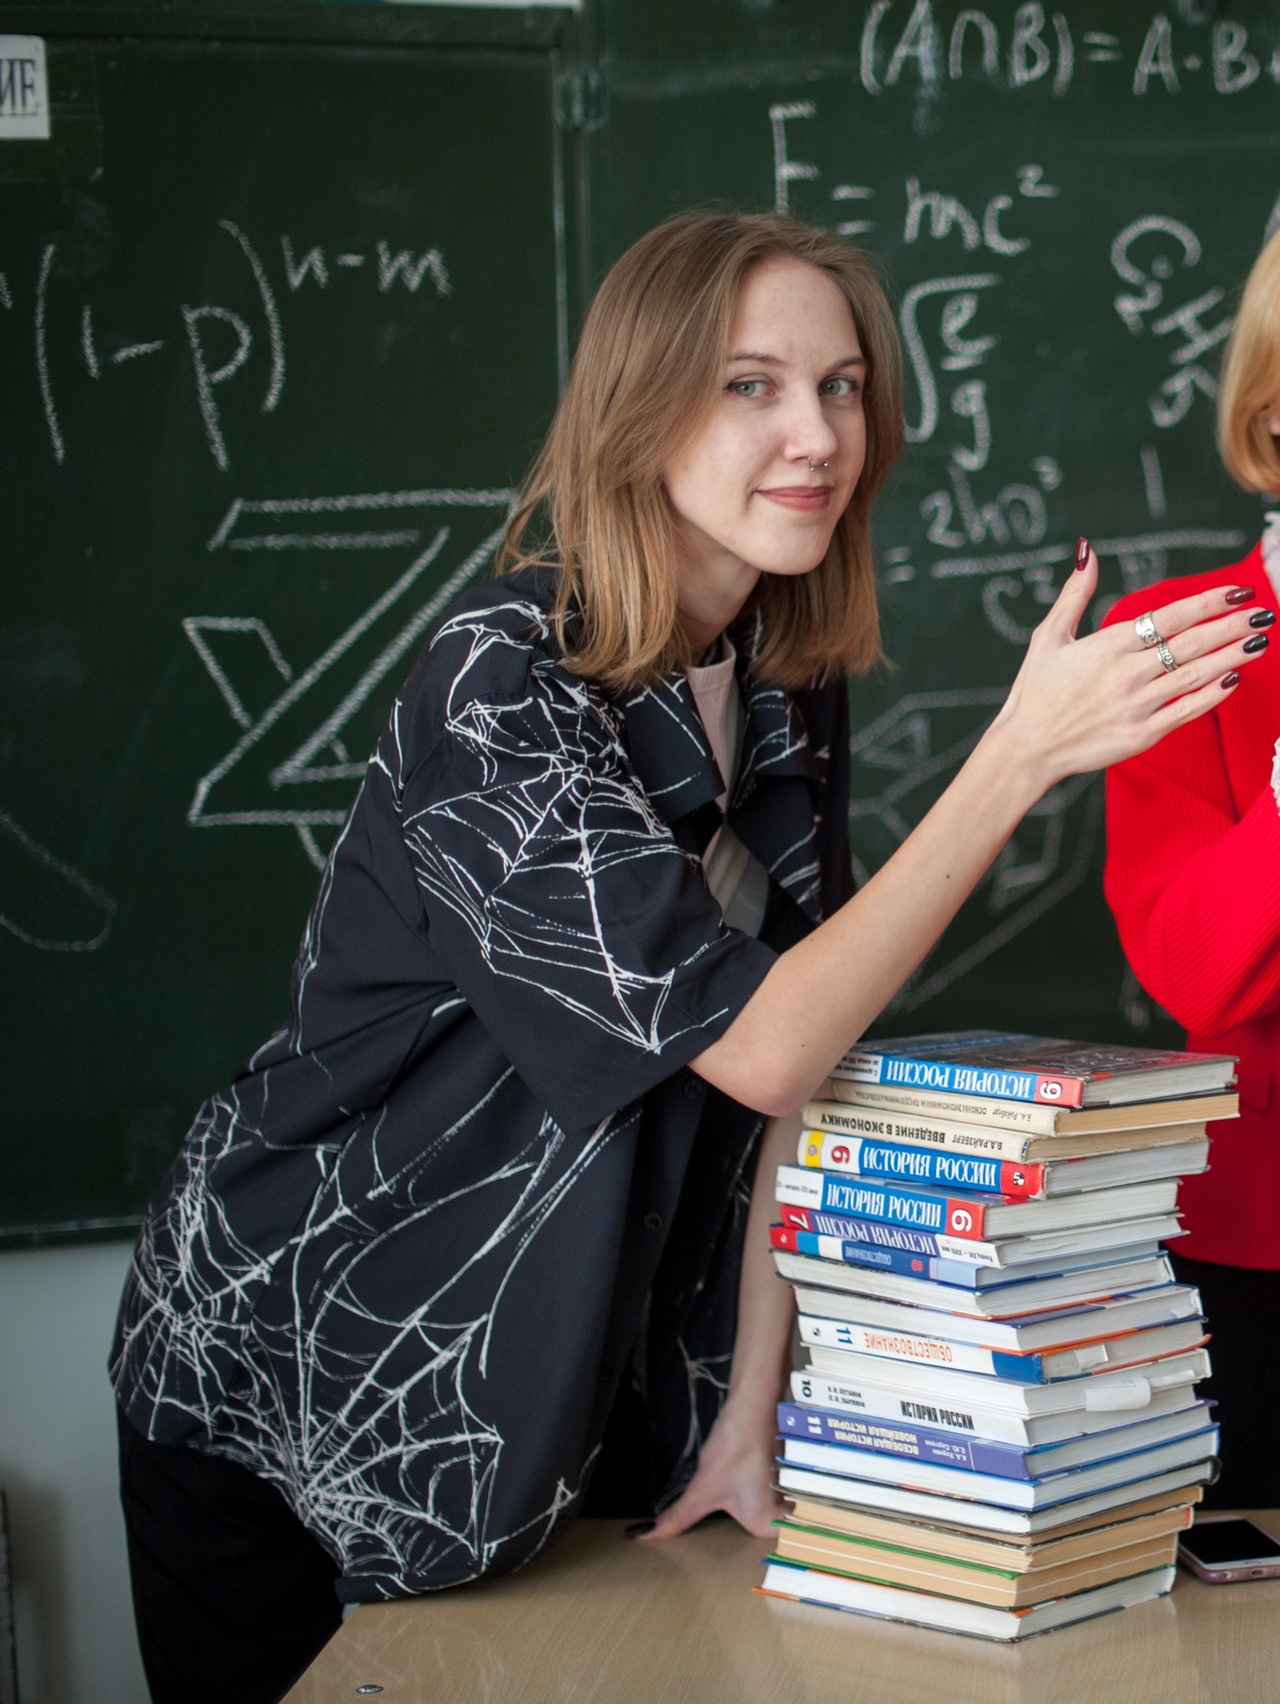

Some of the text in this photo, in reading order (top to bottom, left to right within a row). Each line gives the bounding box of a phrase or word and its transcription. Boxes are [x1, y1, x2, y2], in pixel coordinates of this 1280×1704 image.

[886, 1059, 950, 1089] РОССИИ
[953, 1071, 1032, 1099] ИСТОРИЯ
[820, 1113, 884, 1133] ЭКОНОМИКУ
[886, 1124, 893, 1134] В
[894, 1127, 946, 1144] ВВЕДЕНИЕ
[862, 1146, 932, 1177] ИСТОРИЯ
[935, 1156, 997, 1187] РОССИИ
[826, 1183, 886, 1216] ИСТОРИЯ
[888, 1194, 942, 1228] РОССИИ
[815, 1214, 868, 1243] РОССИИ
[870, 1225, 937, 1255] ИСТОРИЯ
[863, 1331, 953, 1363] ОБЩЕСТВОЗНАНИЕ
[801, 1379, 812, 1398] 10
[900, 1399, 975, 1431] ИСТОРИЯ РОССИИ
[827, 1416, 917, 1444] НОВЕЙШАЯ ИСТОРИЯ
[834, 1429, 919, 1456] ВСЕОБЩАЯ ИСТОРИЯ
